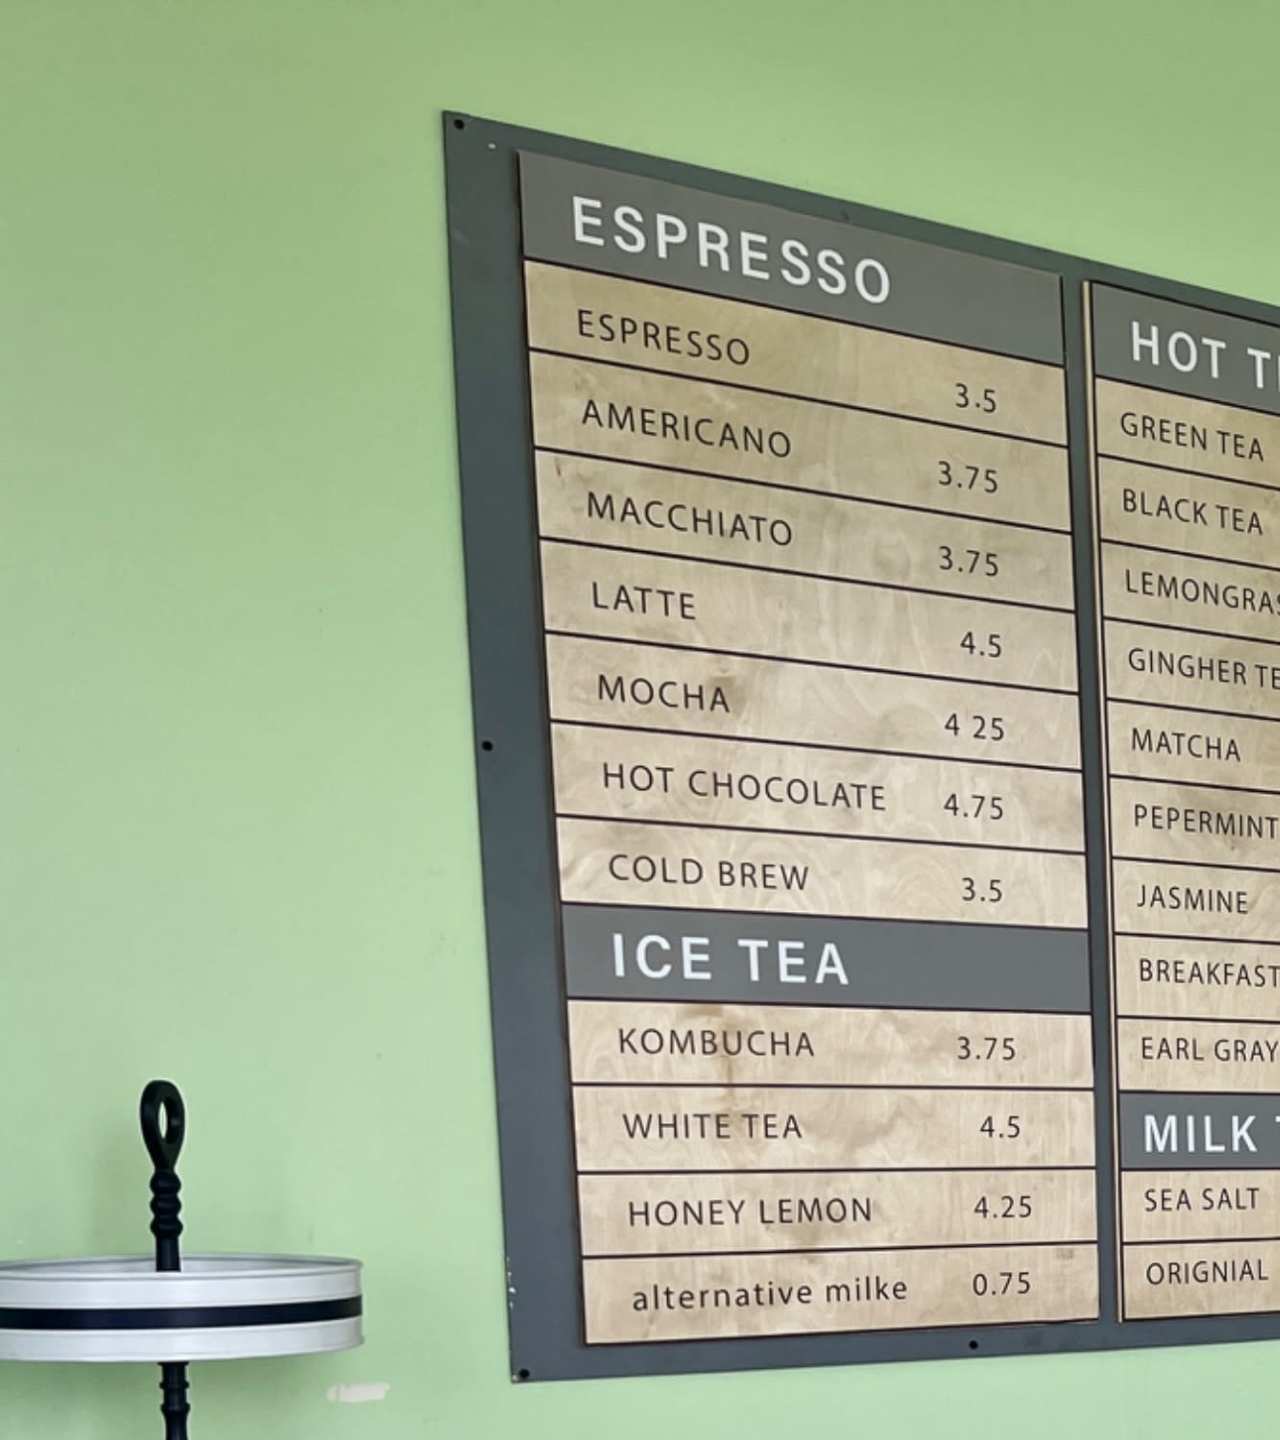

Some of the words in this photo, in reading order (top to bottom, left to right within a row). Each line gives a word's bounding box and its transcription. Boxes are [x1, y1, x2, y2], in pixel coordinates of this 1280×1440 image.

[572, 196, 891, 305] ESPRESSO
[578, 309, 750, 366] ESPRESSO
[954, 383, 997, 413] 3.5
[1131, 320, 1225, 379] HOT
[582, 399, 792, 458] AMERICANO
[938, 460, 999, 494] 3.75
[1120, 412, 1207, 451] GREEN
[1217, 430, 1264, 462] TEA
[1123, 488, 1207, 527] BLACK
[1217, 505, 1263, 536] TEA
[587, 491, 793, 546] MACCHIATO
[939, 545, 999, 577] 3.75
[592, 581, 696, 620] LATTE
[960, 631, 1002, 659] 4.5
[1128, 647, 1246, 686] GINGHER
[598, 674, 731, 714] MOCHA
[1131, 727, 1241, 763] MATCHA
[602, 762, 674, 794] HOT
[688, 770, 886, 811] CHOCOLATE
[944, 794, 1004, 821] 4.75
[1134, 805, 1279, 840] PEPERMINT
[608, 854, 703, 885] COLD
[718, 862, 809, 891] BREW
[961, 878, 1002, 903] 3.5
[1137, 885, 1248, 915] JASMINE
[612, 933, 712, 981] ICE
[738, 939, 849, 985] TEA
[618, 1028, 814, 1058] KOMBUCHA
[956, 1036, 1016, 1061] 3.75
[1141, 1037, 1204, 1061] EARL
[1214, 1039, 1279, 1063] GRAY
[622, 1113, 730, 1140] WHITE
[743, 1114, 802, 1140] TEA
[980, 1116, 1021, 1139] 4.5
[1143, 1115, 1257, 1153] MILK
[628, 1200, 745, 1227] HONEY
[758, 1197, 872, 1224] LEMON
[974, 1196, 1032, 1220] 4.25
[1144, 1189, 1192, 1212] SEA
[1202, 1187, 1260, 1210] SALT
[632, 1280, 813, 1312] alternative
[826, 1275, 908, 1301] milke
[972, 1272, 1031, 1296] 0.75
[1146, 1259, 1269, 1285] ORIGNIAL
